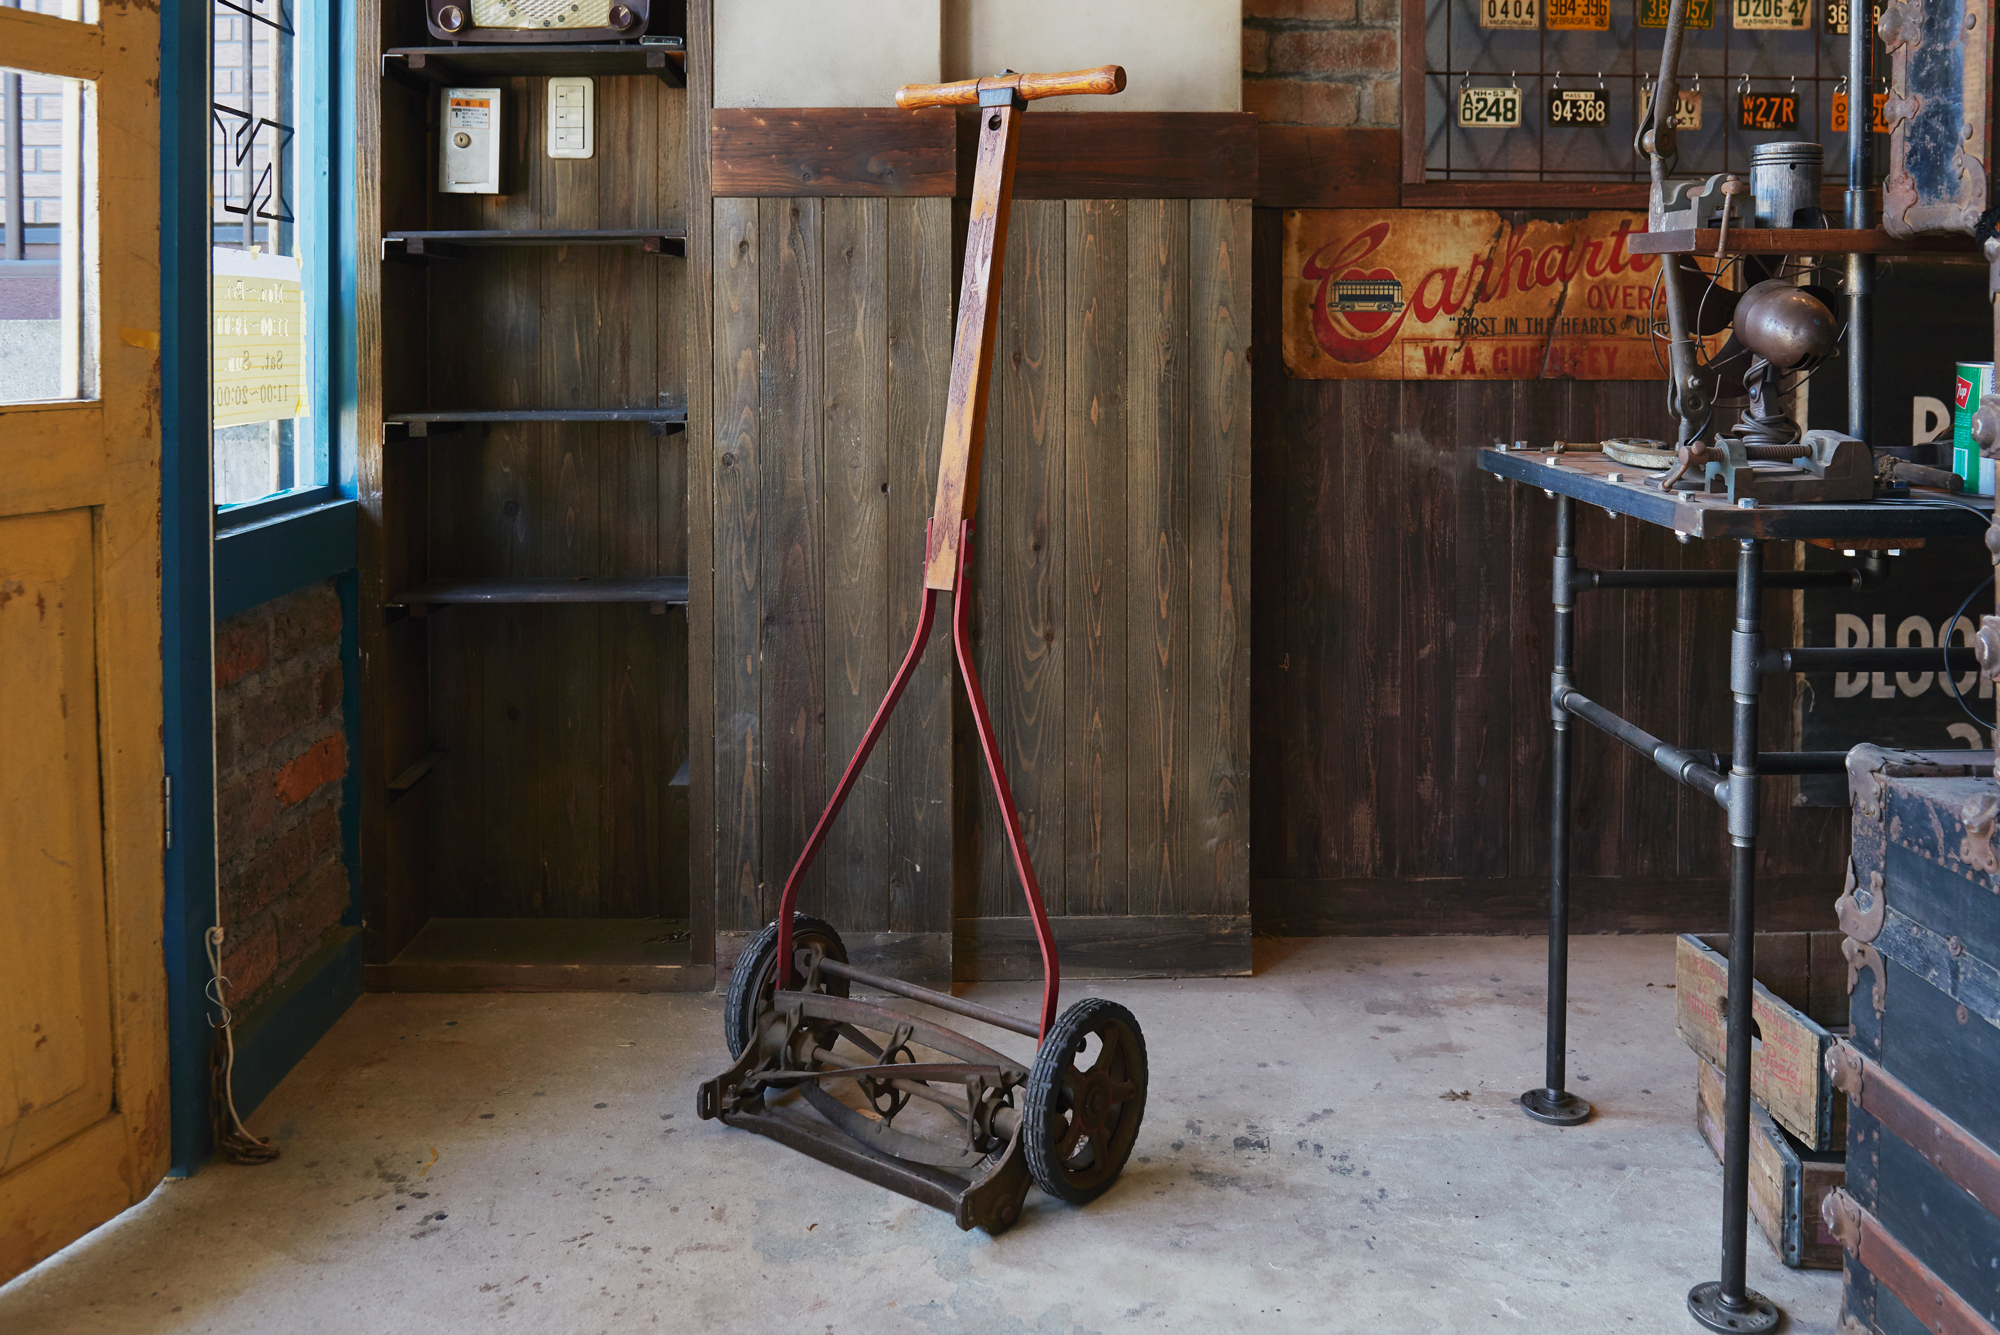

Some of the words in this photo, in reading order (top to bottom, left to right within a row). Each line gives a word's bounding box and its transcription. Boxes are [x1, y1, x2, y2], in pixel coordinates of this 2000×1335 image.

[1550, 0, 1607, 16] 984-396
[1549, 16, 1590, 25] NEBRASKA
[1552, 100, 1606, 122] 94-368
[1755, 97, 1795, 123] 27R
[1587, 285, 1668, 311] OVERA
[1505, 317, 1518, 335] IN
[1560, 317, 1617, 336] HEARTS
[1697, 979, 1708, 998] 24
[1686, 991, 1718, 1028] BOTTLES
